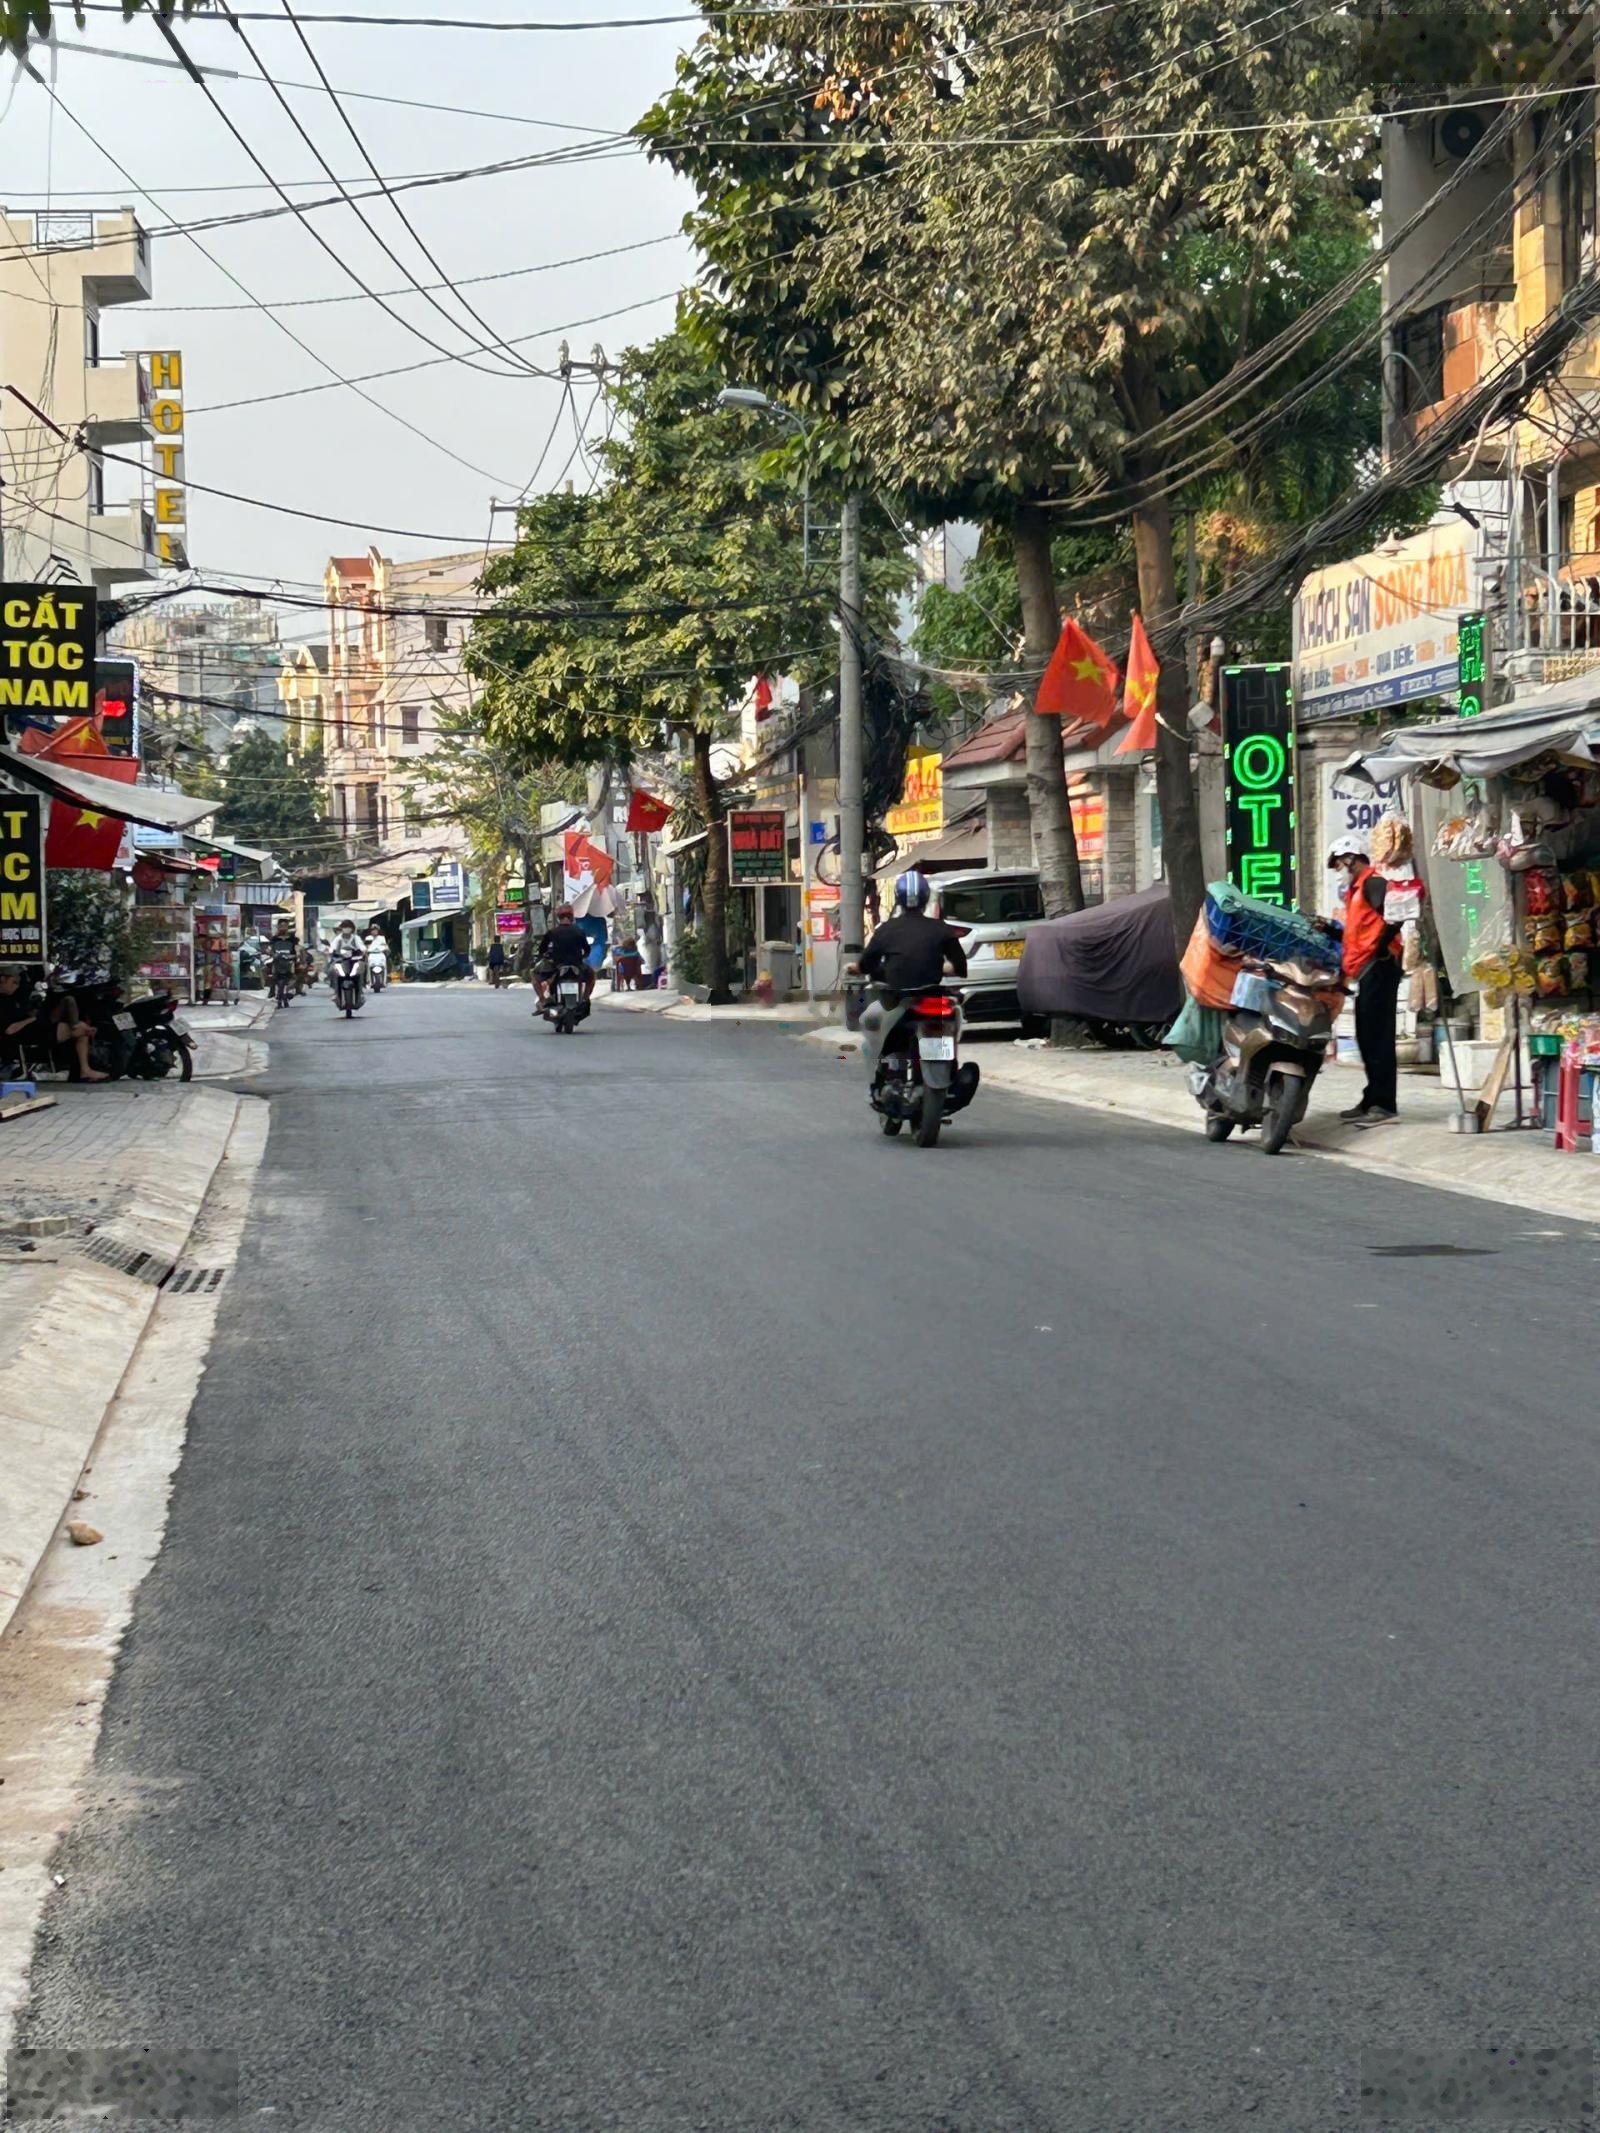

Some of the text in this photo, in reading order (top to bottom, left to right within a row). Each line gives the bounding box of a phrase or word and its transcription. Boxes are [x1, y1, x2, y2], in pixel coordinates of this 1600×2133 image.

[151, 353, 186, 567] HOTEL
[4, 592, 84, 630] CẮT
[2, 635, 84, 671] TÓC
[0, 679, 89, 708] NAM
